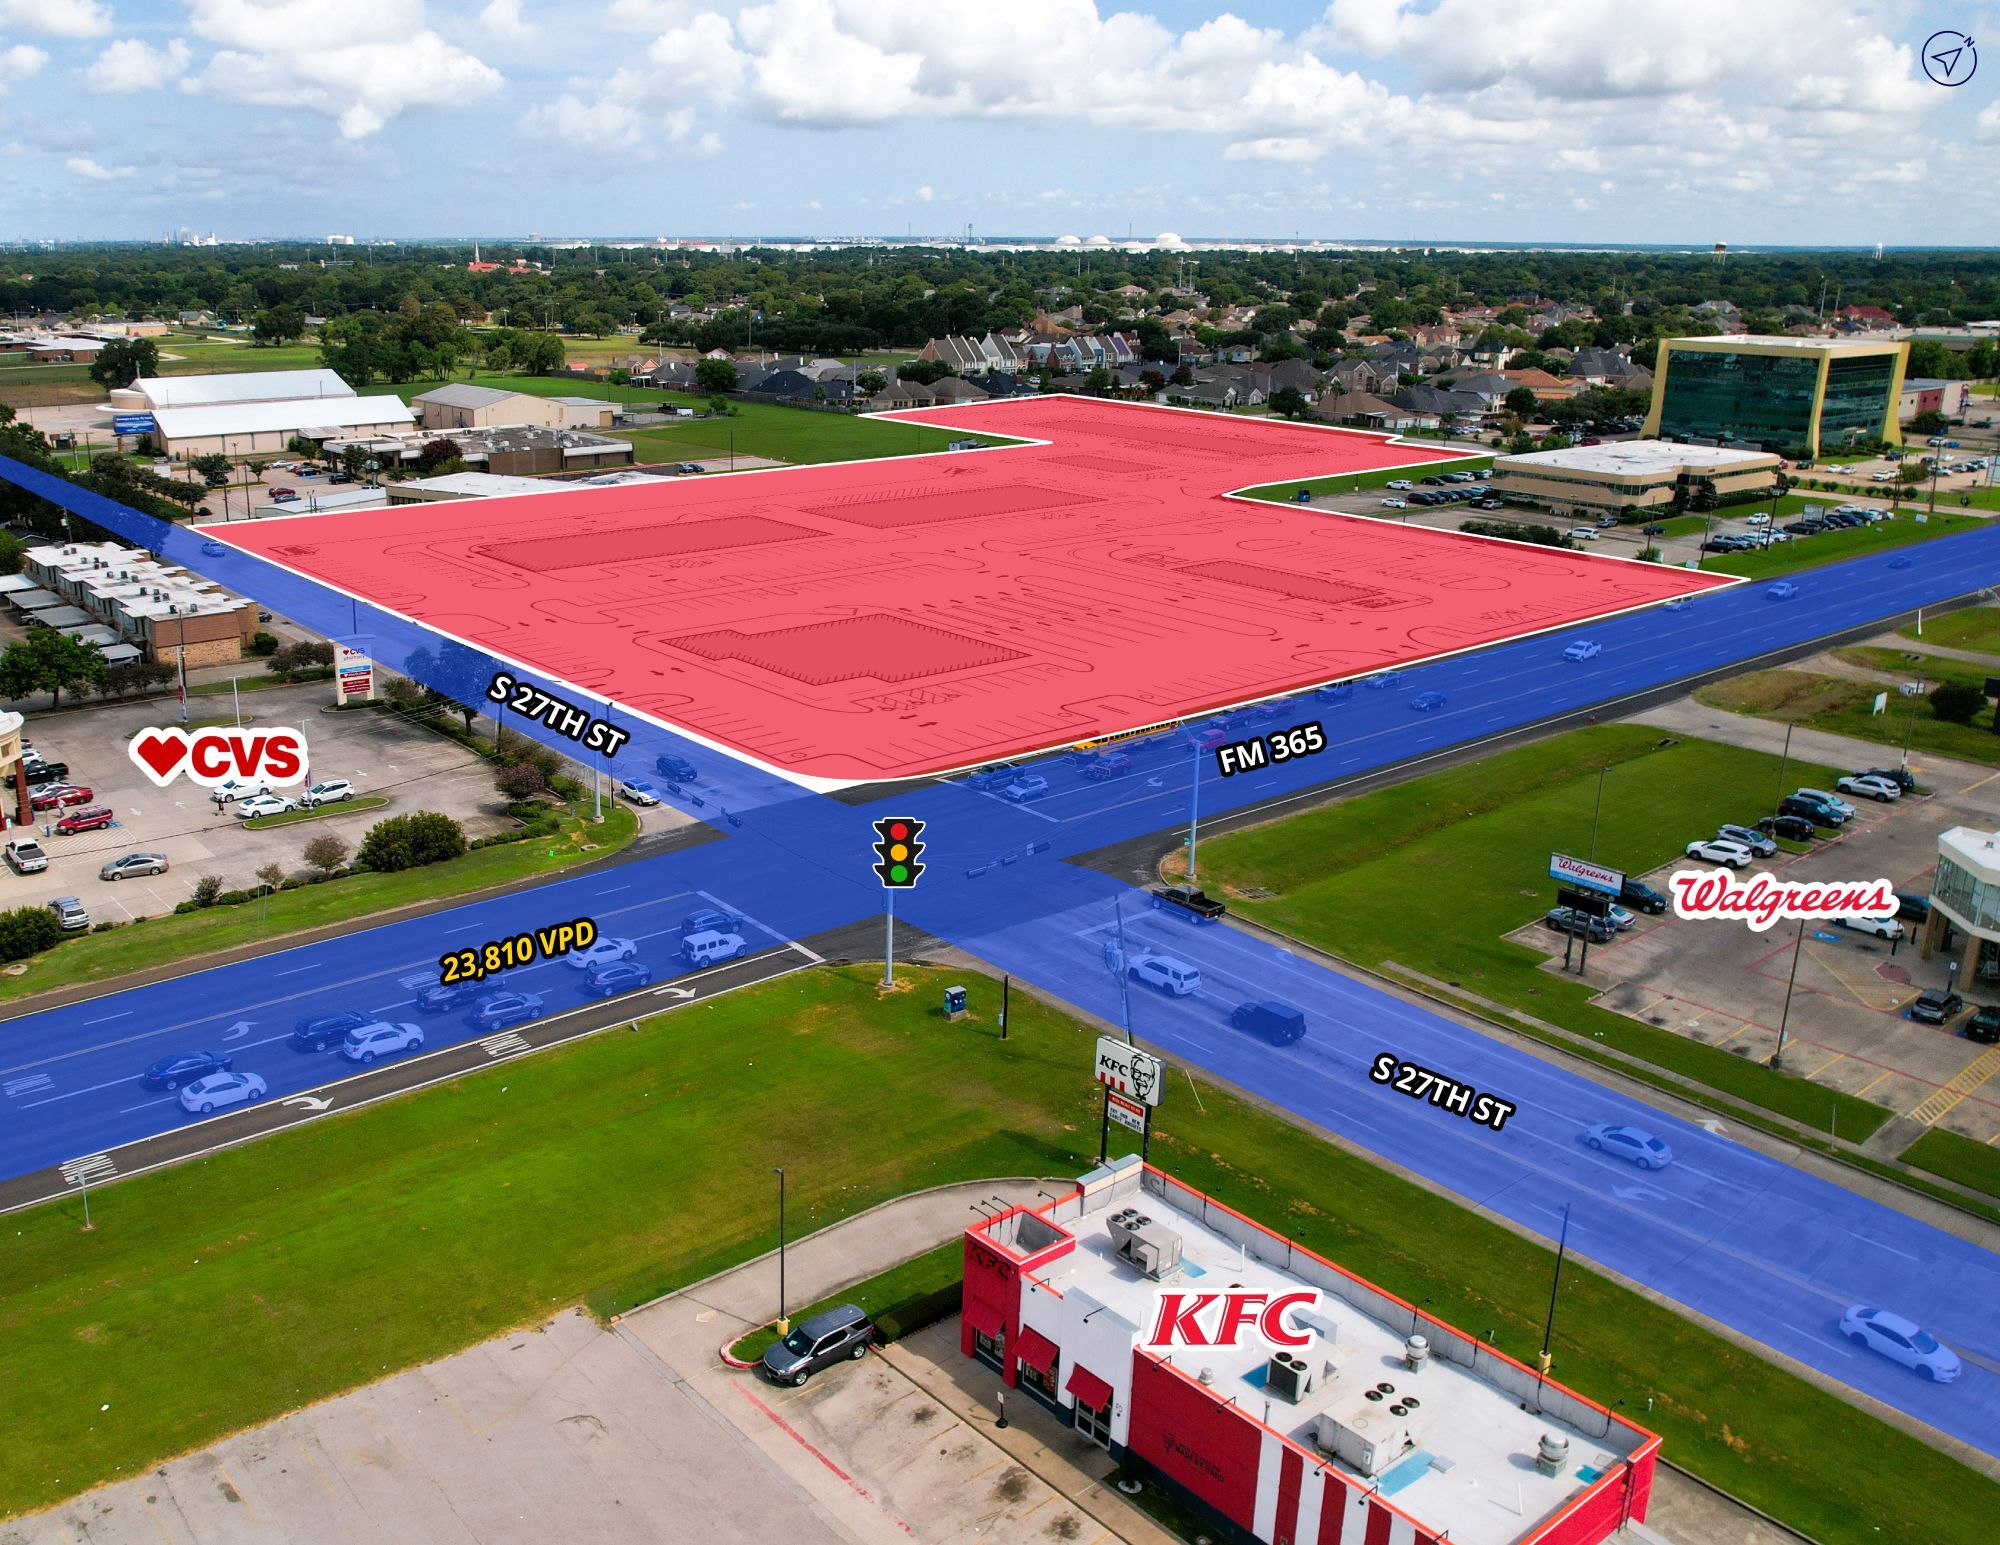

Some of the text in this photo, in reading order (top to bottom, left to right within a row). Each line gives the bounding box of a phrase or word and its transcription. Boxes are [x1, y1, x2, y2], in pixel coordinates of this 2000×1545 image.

[350, 647, 366, 656] CVS
[1558, 858, 1614, 883] Walgreens
[1099, 1054, 1129, 1077] KFC
[968, 1240, 1011, 1281] KFC
